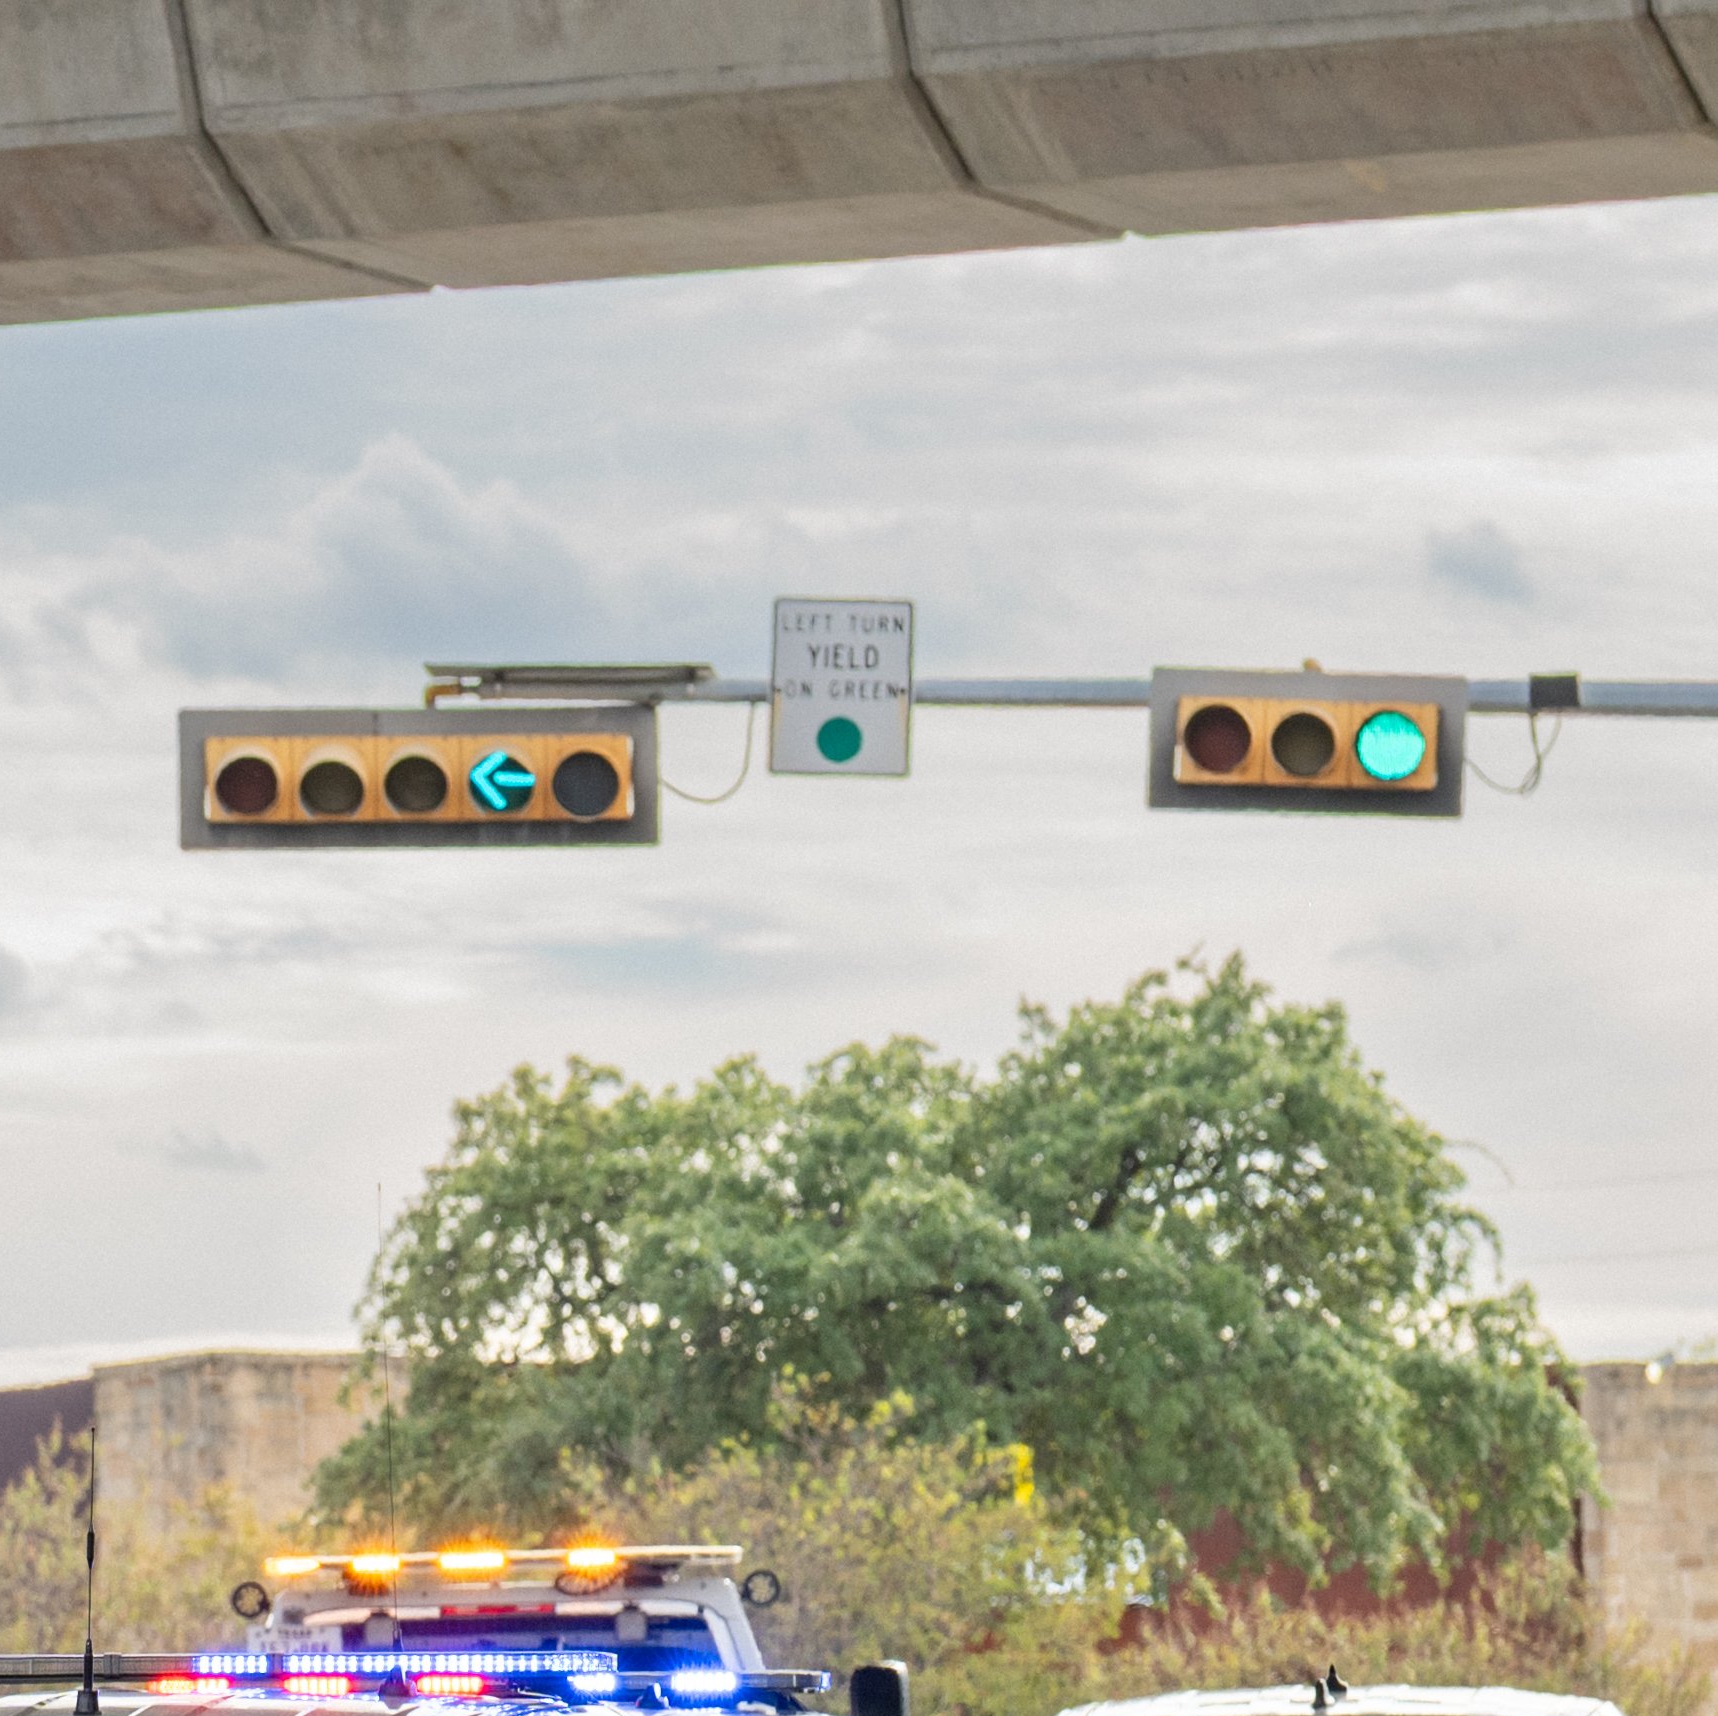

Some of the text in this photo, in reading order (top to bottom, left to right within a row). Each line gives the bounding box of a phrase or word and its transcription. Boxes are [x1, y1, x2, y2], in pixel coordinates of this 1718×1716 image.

[781, 613, 906, 633] LEFT TURN
[807, 643, 880, 670] YIELD
[785, 679, 900, 700] ON GREEN
